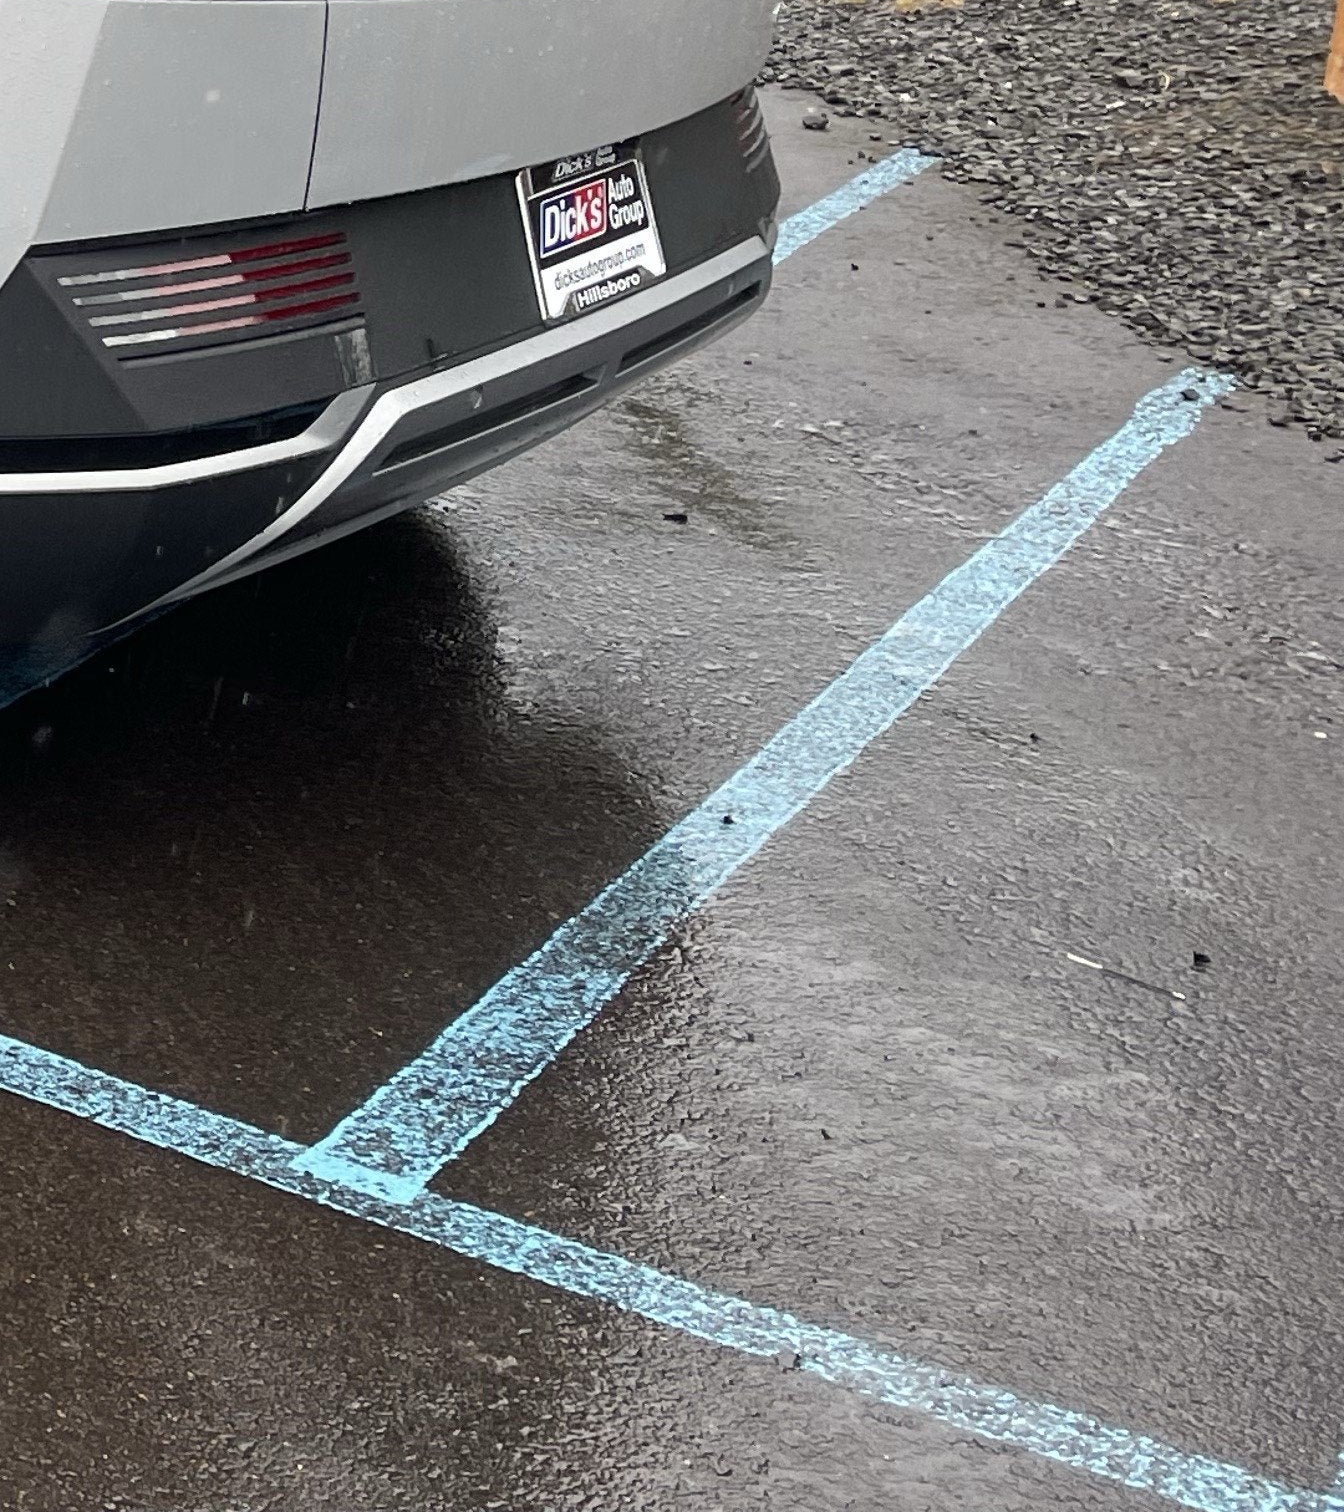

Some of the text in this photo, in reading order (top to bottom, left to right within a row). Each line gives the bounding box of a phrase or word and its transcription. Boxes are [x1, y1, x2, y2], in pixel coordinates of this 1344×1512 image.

[608, 174, 635, 204] Auto
[544, 185, 603, 248] Dick's
[608, 199, 645, 230] Group
[554, 243, 647, 291] dicksautogroup.com
[576, 273, 642, 308] Hillsboro
